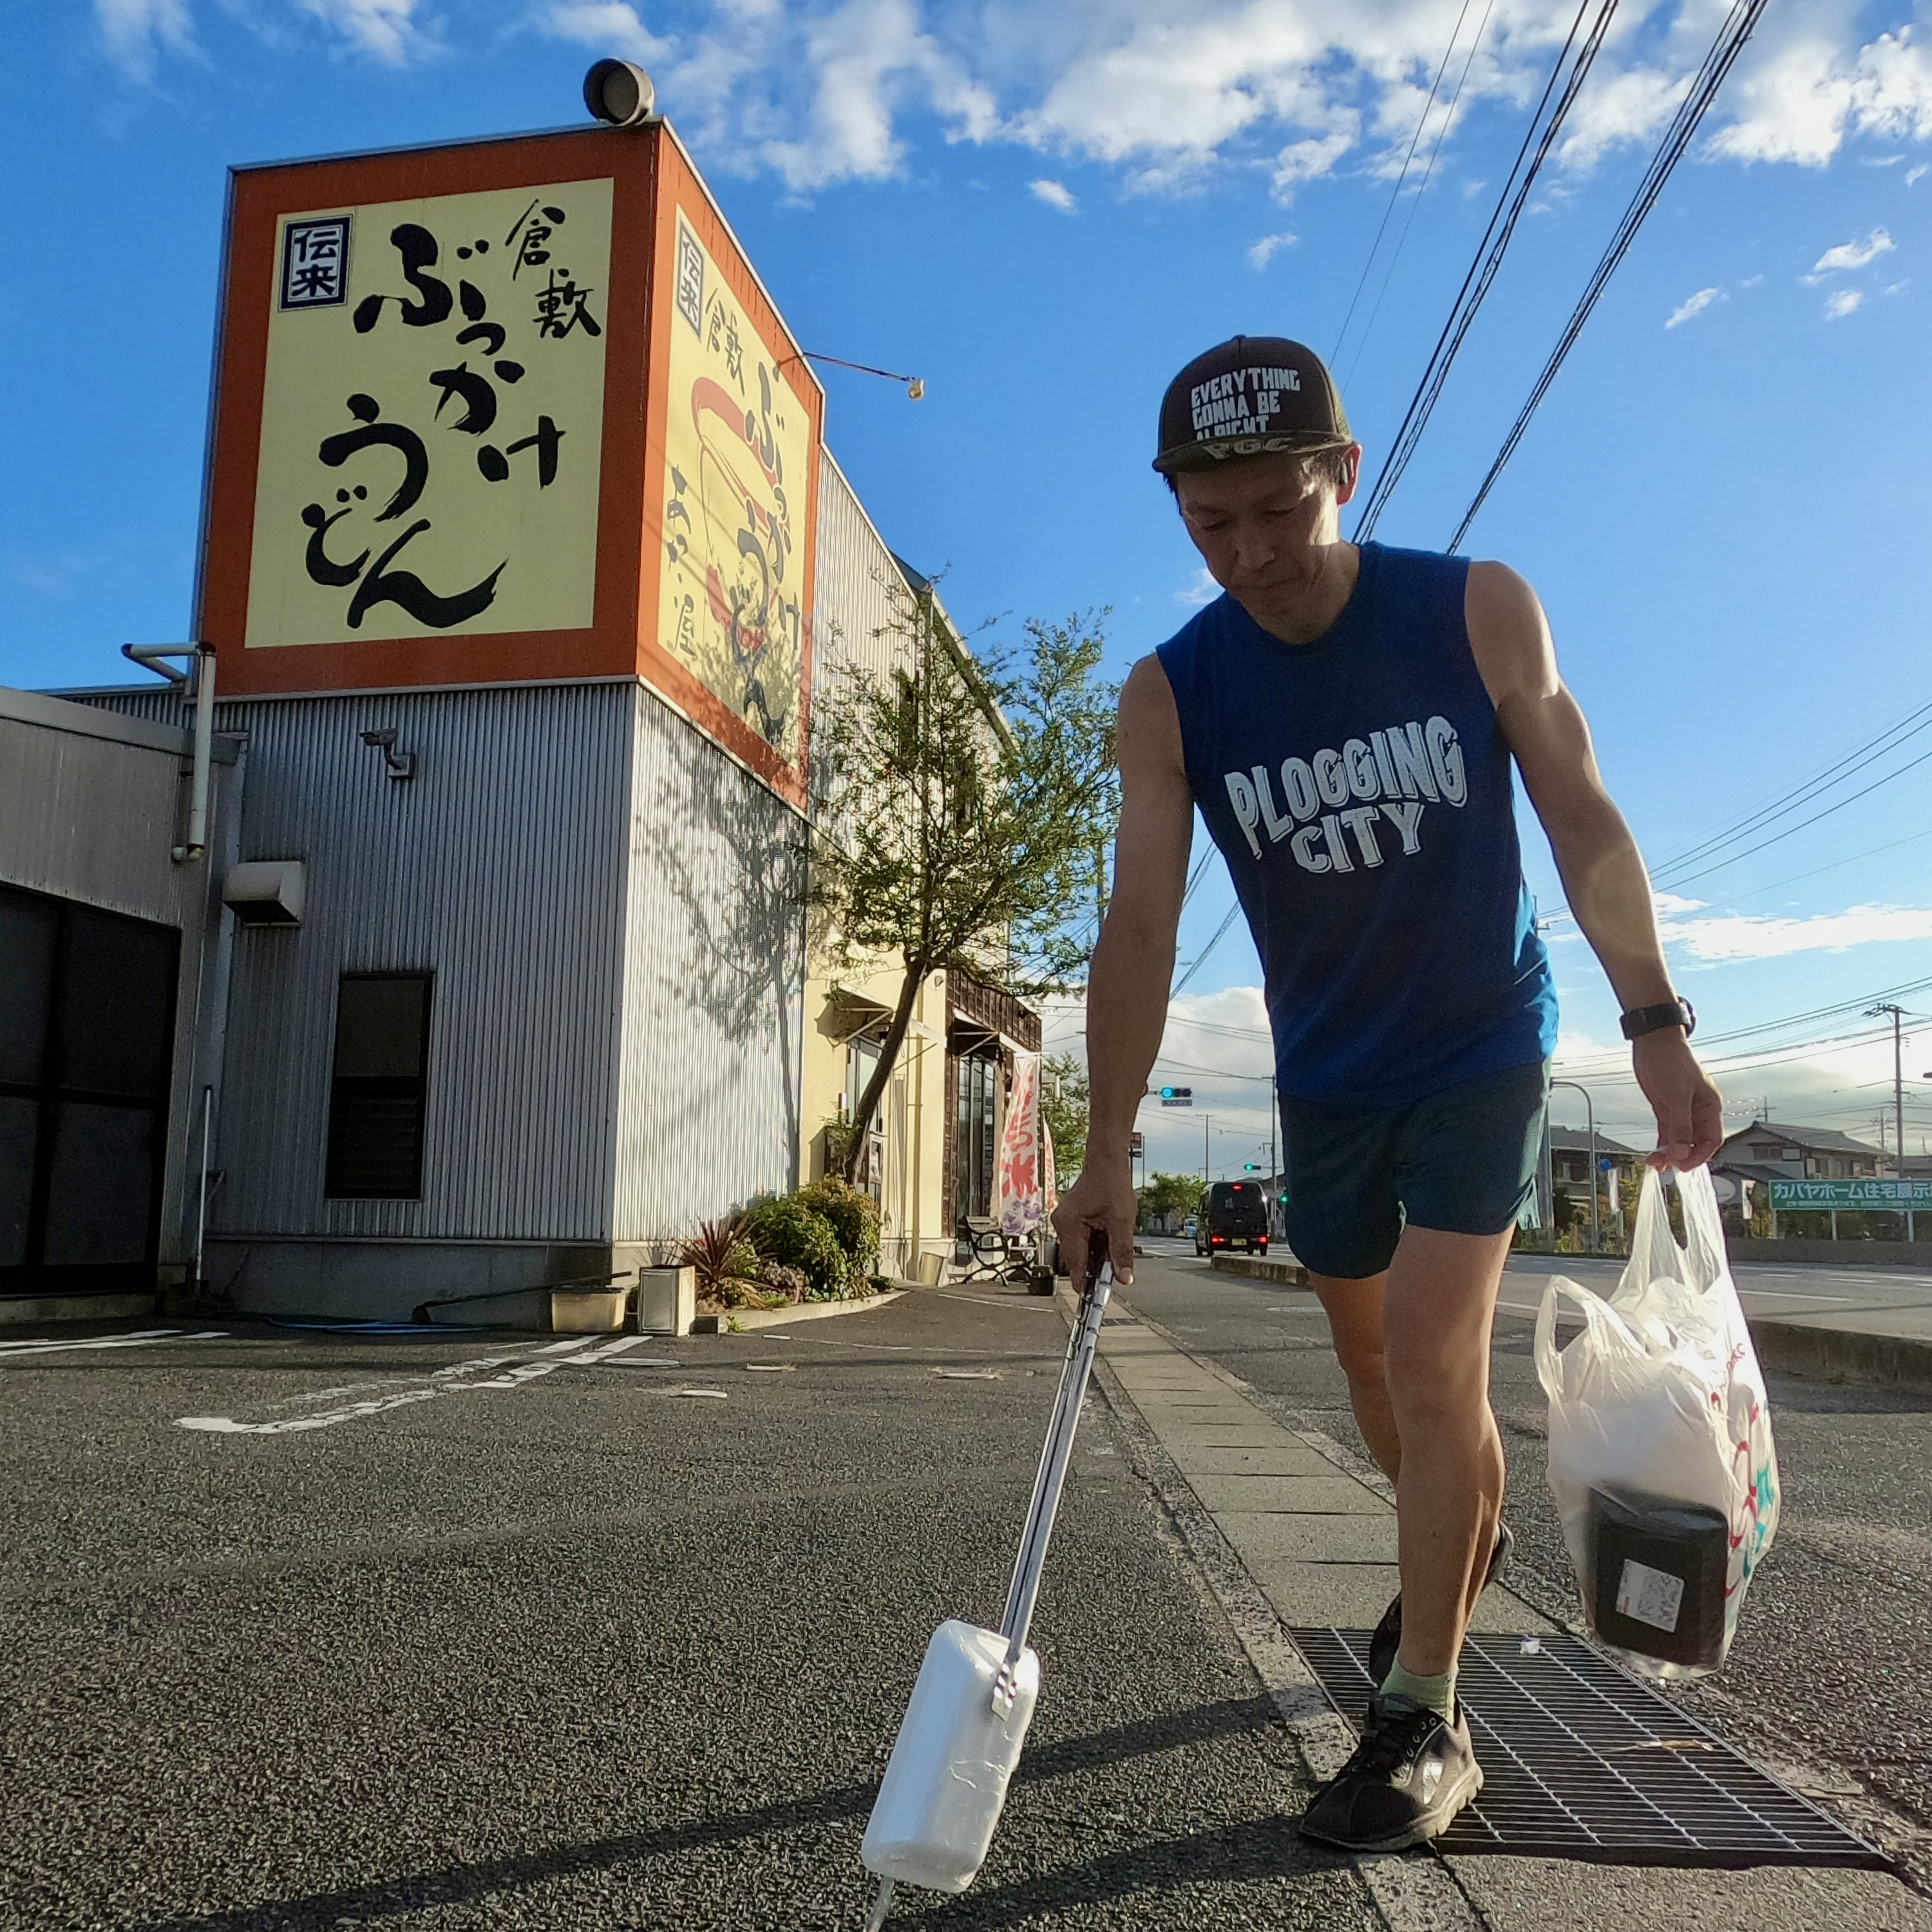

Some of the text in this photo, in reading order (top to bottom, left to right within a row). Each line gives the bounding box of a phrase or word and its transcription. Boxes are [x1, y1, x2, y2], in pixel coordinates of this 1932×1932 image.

[292, 228, 339, 298] 伝来
[505, 198, 601, 339] 倉敷
[681, 238, 699, 323] 伝来
[353, 223, 567, 489] ぶっかけ
[705, 287, 745, 397] 倉敷
[1191, 366, 1300, 408] EVERYTHING
[1192, 390, 1280, 430] GONNA BE
[301, 393, 509, 629] うどん
[1224, 715, 1468, 860] PLOGGING
[1290, 802, 1425, 873] CITY
[1774, 1182, 1932, 1200] カバヤホーム住宅展示
